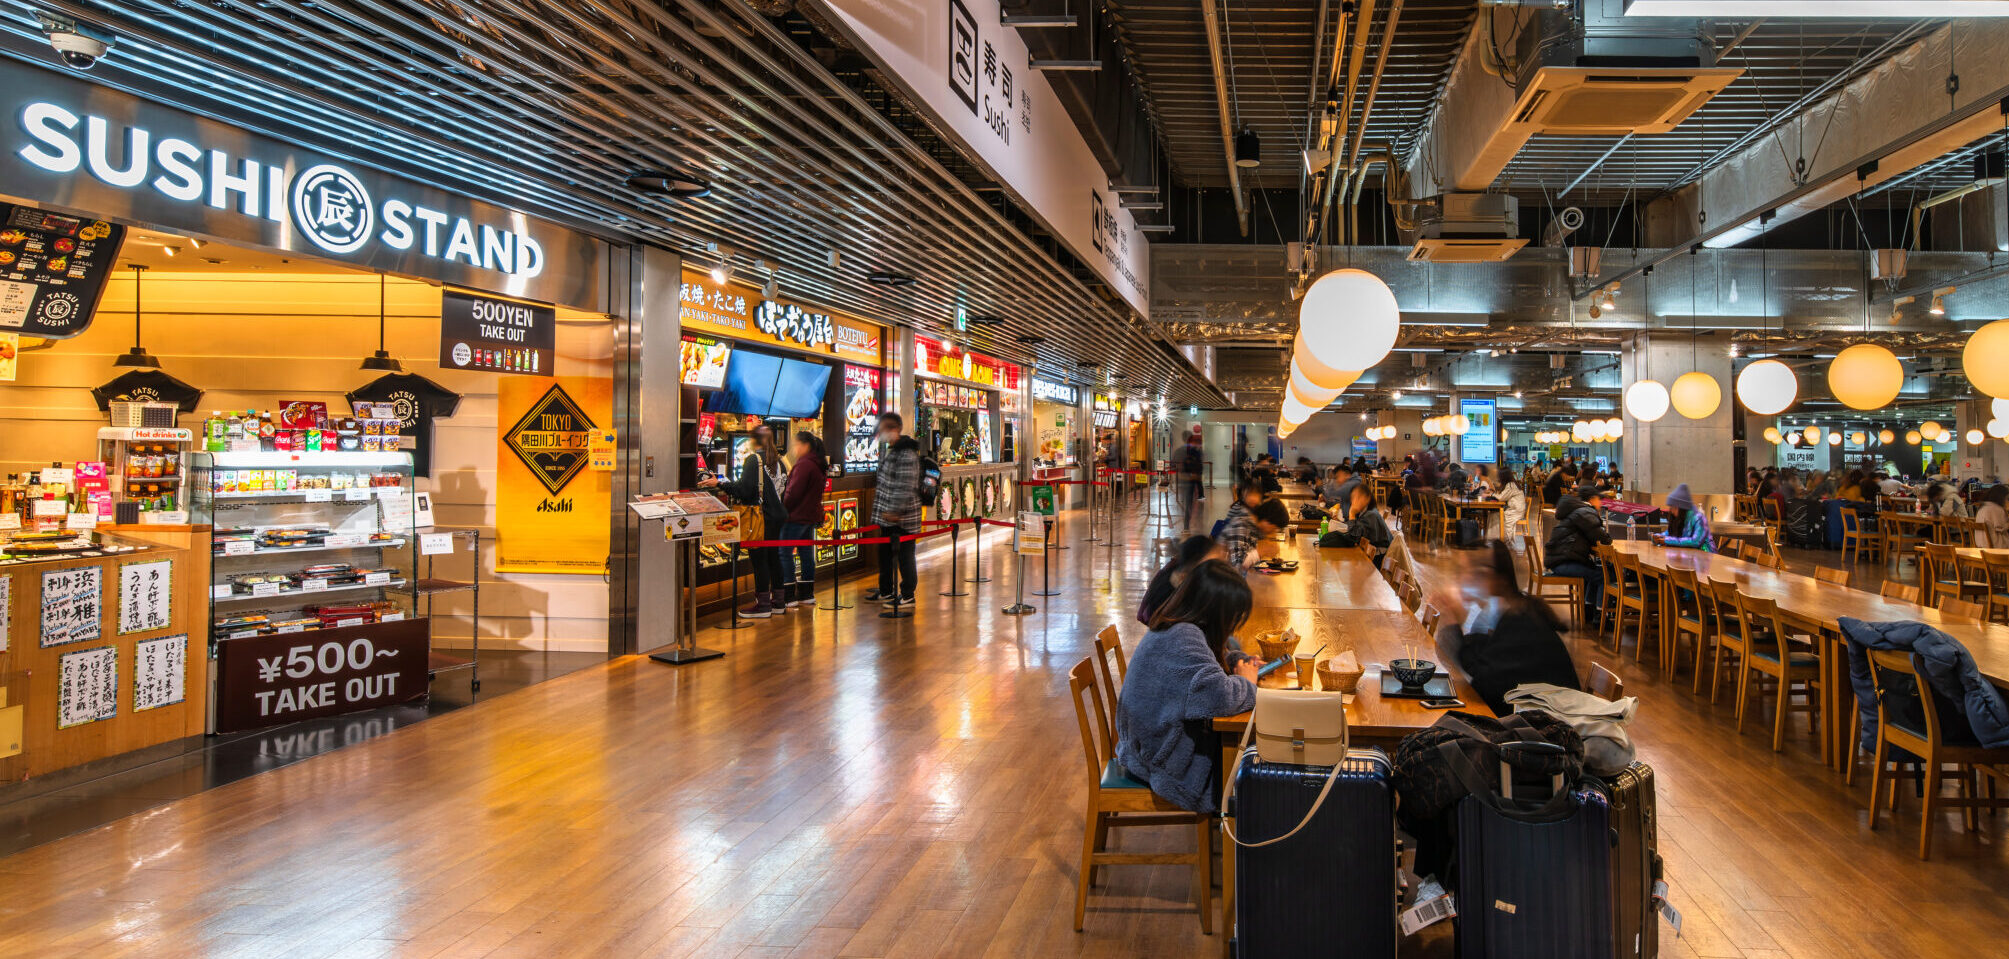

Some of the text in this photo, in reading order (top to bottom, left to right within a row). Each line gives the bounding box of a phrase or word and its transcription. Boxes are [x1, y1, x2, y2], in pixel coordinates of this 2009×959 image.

[984, 93, 1010, 146] Sushi
[19, 102, 544, 278] SUSHI 辰 STAND
[46, 292, 80, 304] TATSU
[472, 299, 533, 328] 500YEN
[36, 316, 70, 327] SUSHI
[480, 324, 526, 342] TAKE OUT
[132, 387, 159, 398] TATSU
[388, 391, 416, 401] TATSU
[400, 419, 416, 429] SHI
[541, 414, 571, 431] TOKYO
[1787, 453, 1815, 462] 国内線
[1788, 462, 1814, 470] Domestic
[537, 497, 573, 512] Asahi
[255, 672, 401, 717] TAKE OUT
